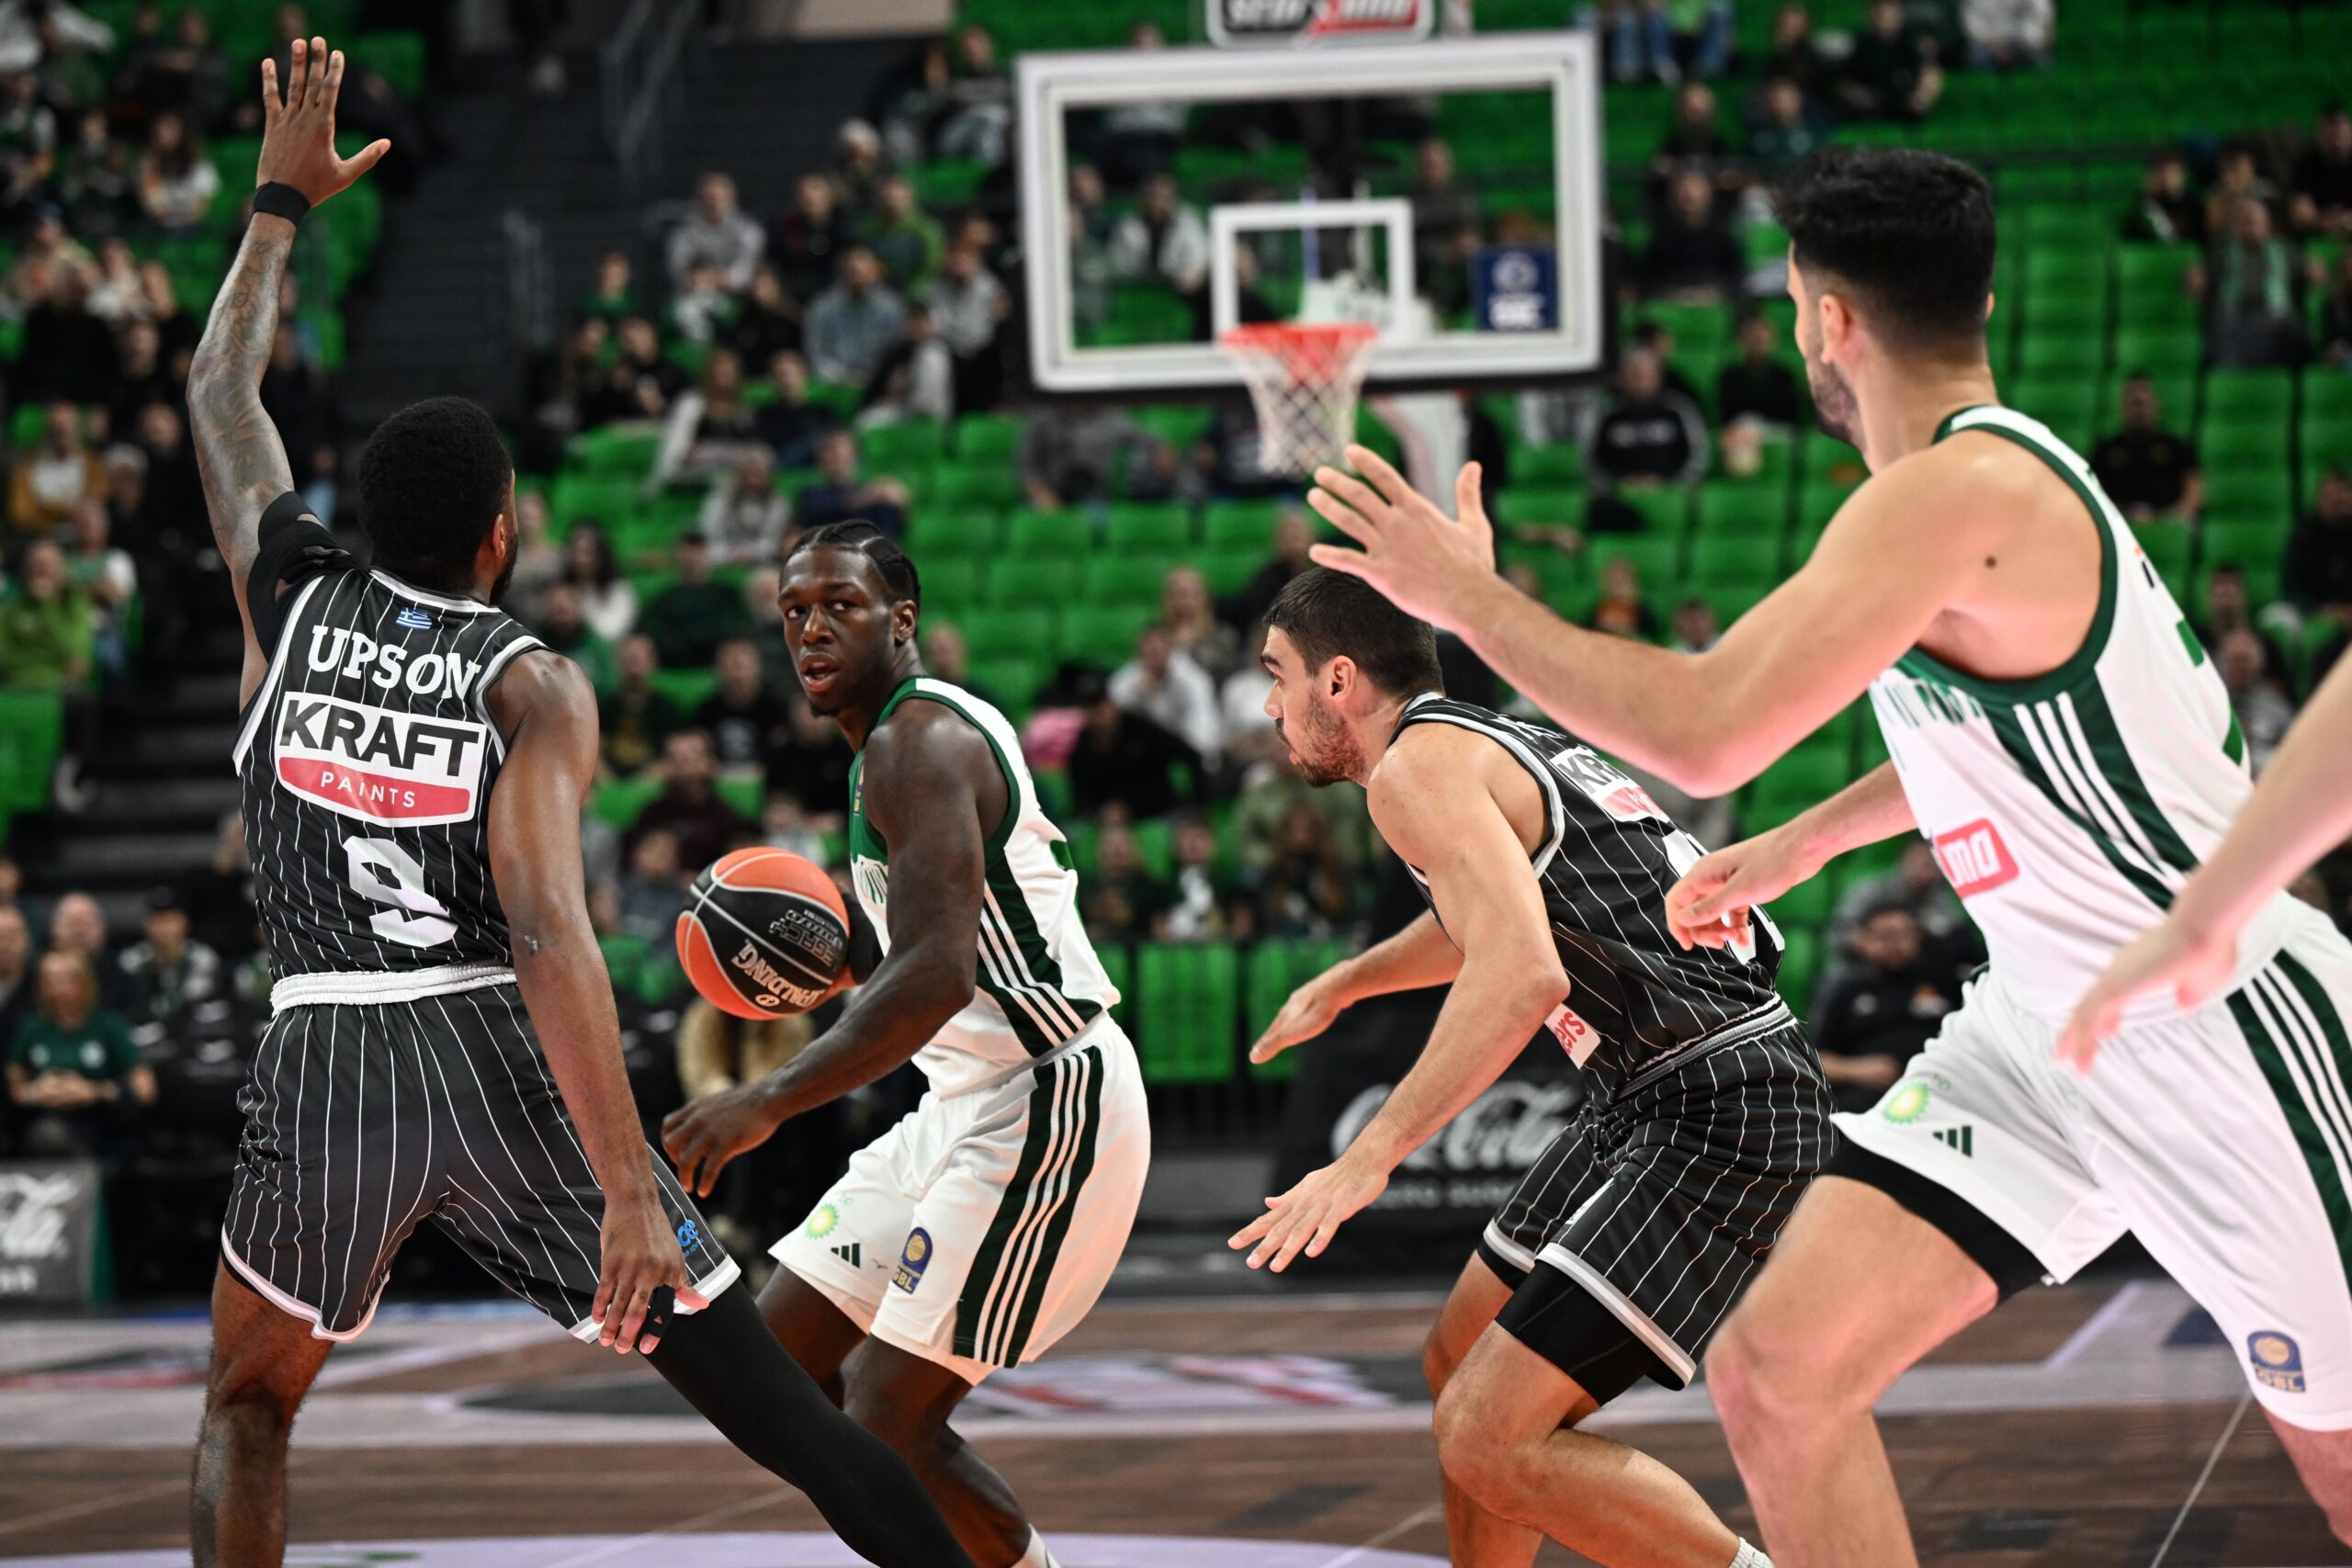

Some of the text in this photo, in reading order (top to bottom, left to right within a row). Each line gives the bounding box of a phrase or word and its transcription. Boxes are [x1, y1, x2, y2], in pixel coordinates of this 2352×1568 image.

[308, 625, 481, 699] UPSON
[278, 699, 481, 778] KRAFT
[320, 771, 416, 808] PAINTS
[342, 835, 459, 949] 9
[731, 940, 826, 1008] SPALDING
